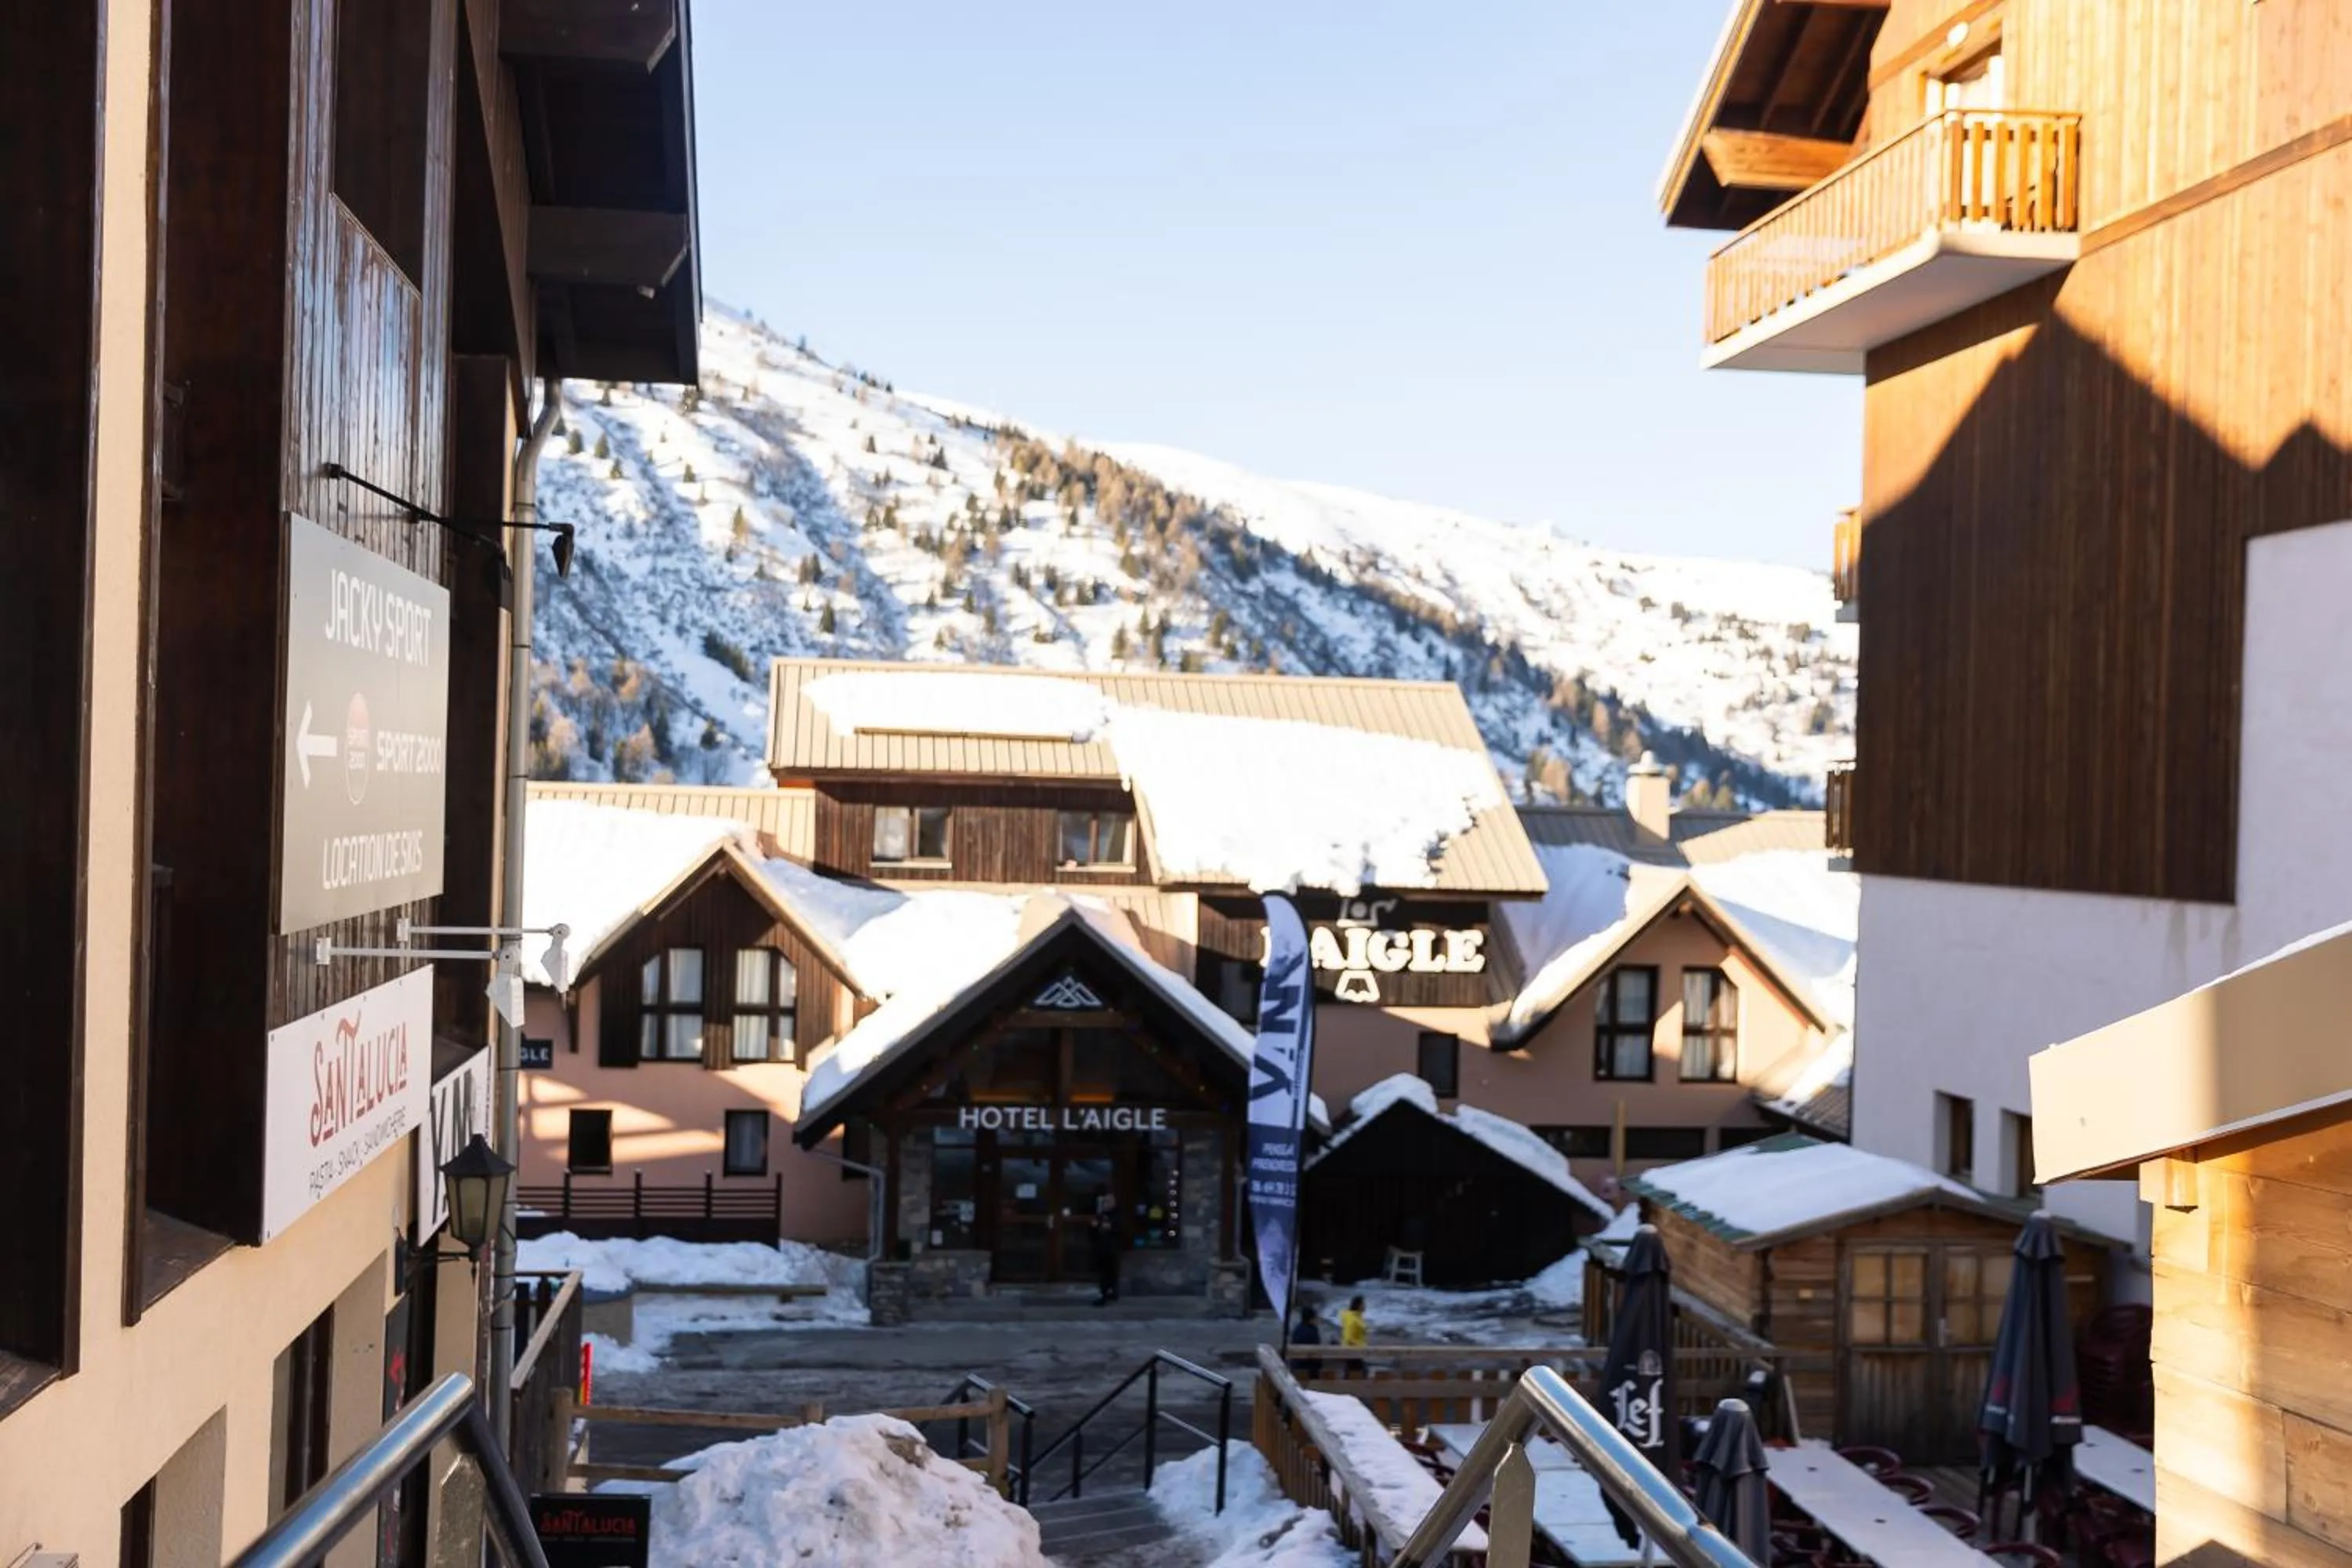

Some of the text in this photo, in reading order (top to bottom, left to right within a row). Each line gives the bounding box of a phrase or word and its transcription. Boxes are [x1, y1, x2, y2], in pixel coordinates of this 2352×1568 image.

[325, 568, 432, 666] JACKY SPORT
[376, 731, 443, 774] SPORT 2000
[323, 829, 423, 890] LOCATION DE SKIS
[1261, 926, 1486, 972] AIGLE
[959, 1106, 1167, 1131] HOTEL L'AIGLE
